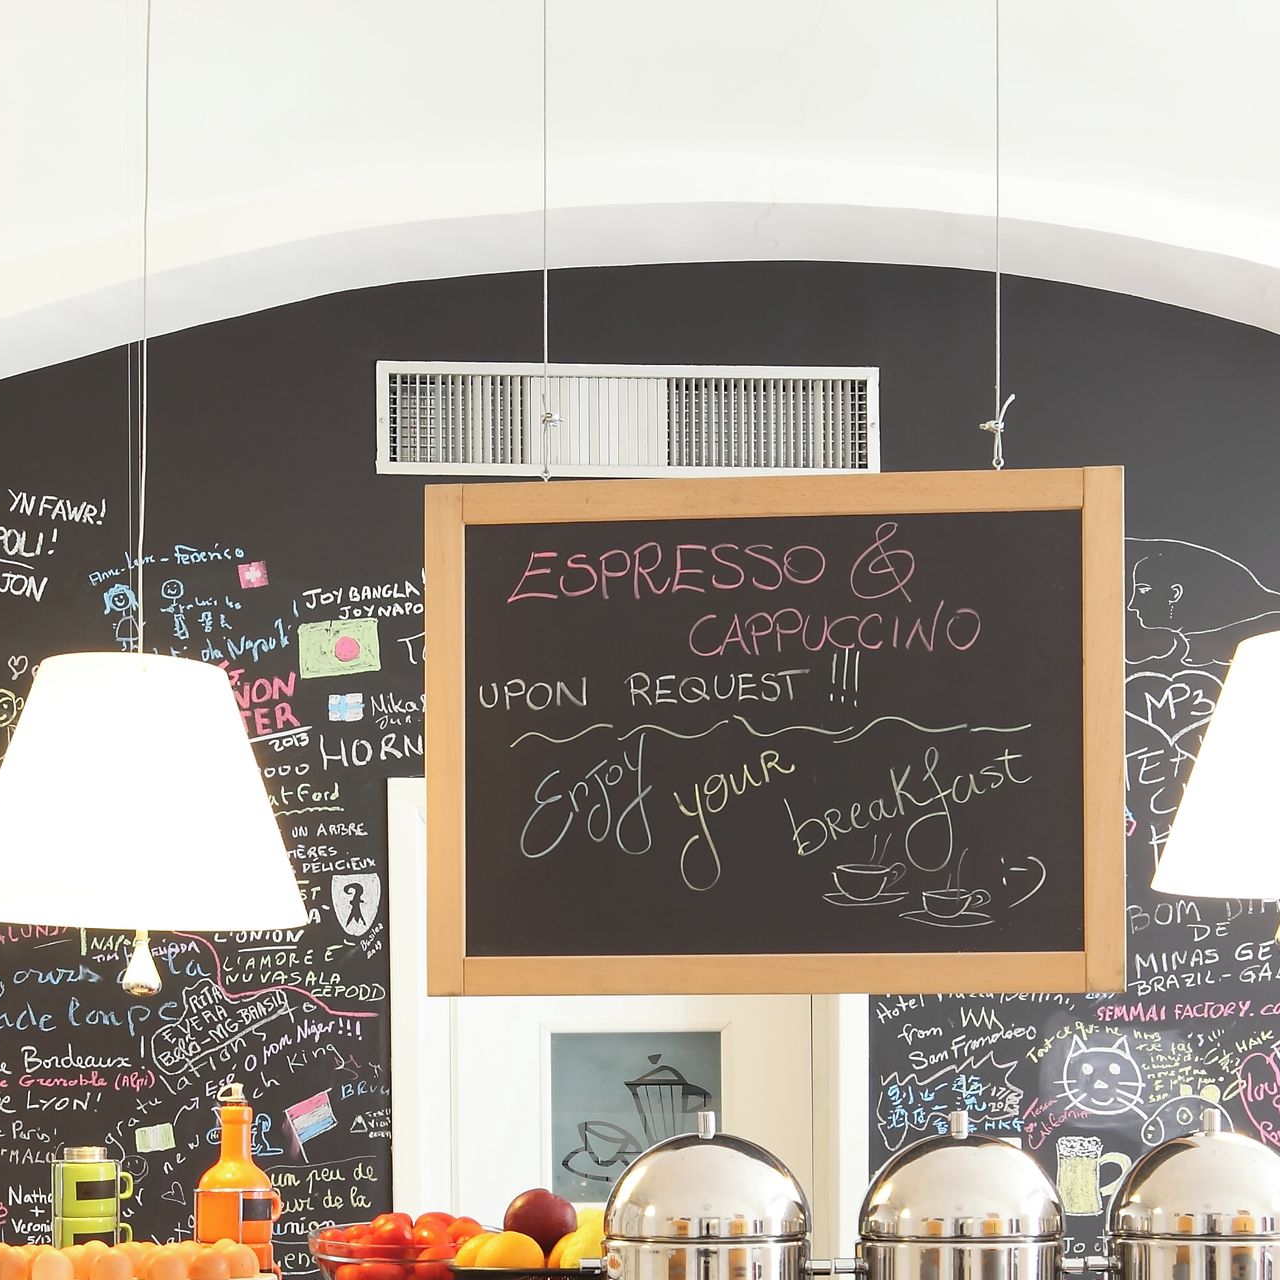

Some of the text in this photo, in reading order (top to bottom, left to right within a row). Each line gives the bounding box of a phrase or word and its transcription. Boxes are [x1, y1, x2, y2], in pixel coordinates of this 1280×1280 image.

[8, 489, 38, 515] YN
[508, 522, 915, 602] ESPRESSO &
[303, 581, 420, 609] JOY BANGLA
[339, 605, 371, 620] JOY
[689, 599, 981, 656] CAPPUCCINO
[478, 669, 810, 710] UPON REQUEST
[269, 734, 309, 752] 2013
[785, 748, 1032, 871] breakfast
[292, 823, 368, 838] UN ARBRE
[1126, 900, 1202, 934] BOM
[1188, 922, 1230, 942] DE
[1135, 949, 1219, 978] MINAS
[899, 1024, 942, 1046] from
[909, 1051, 949, 1070] San
